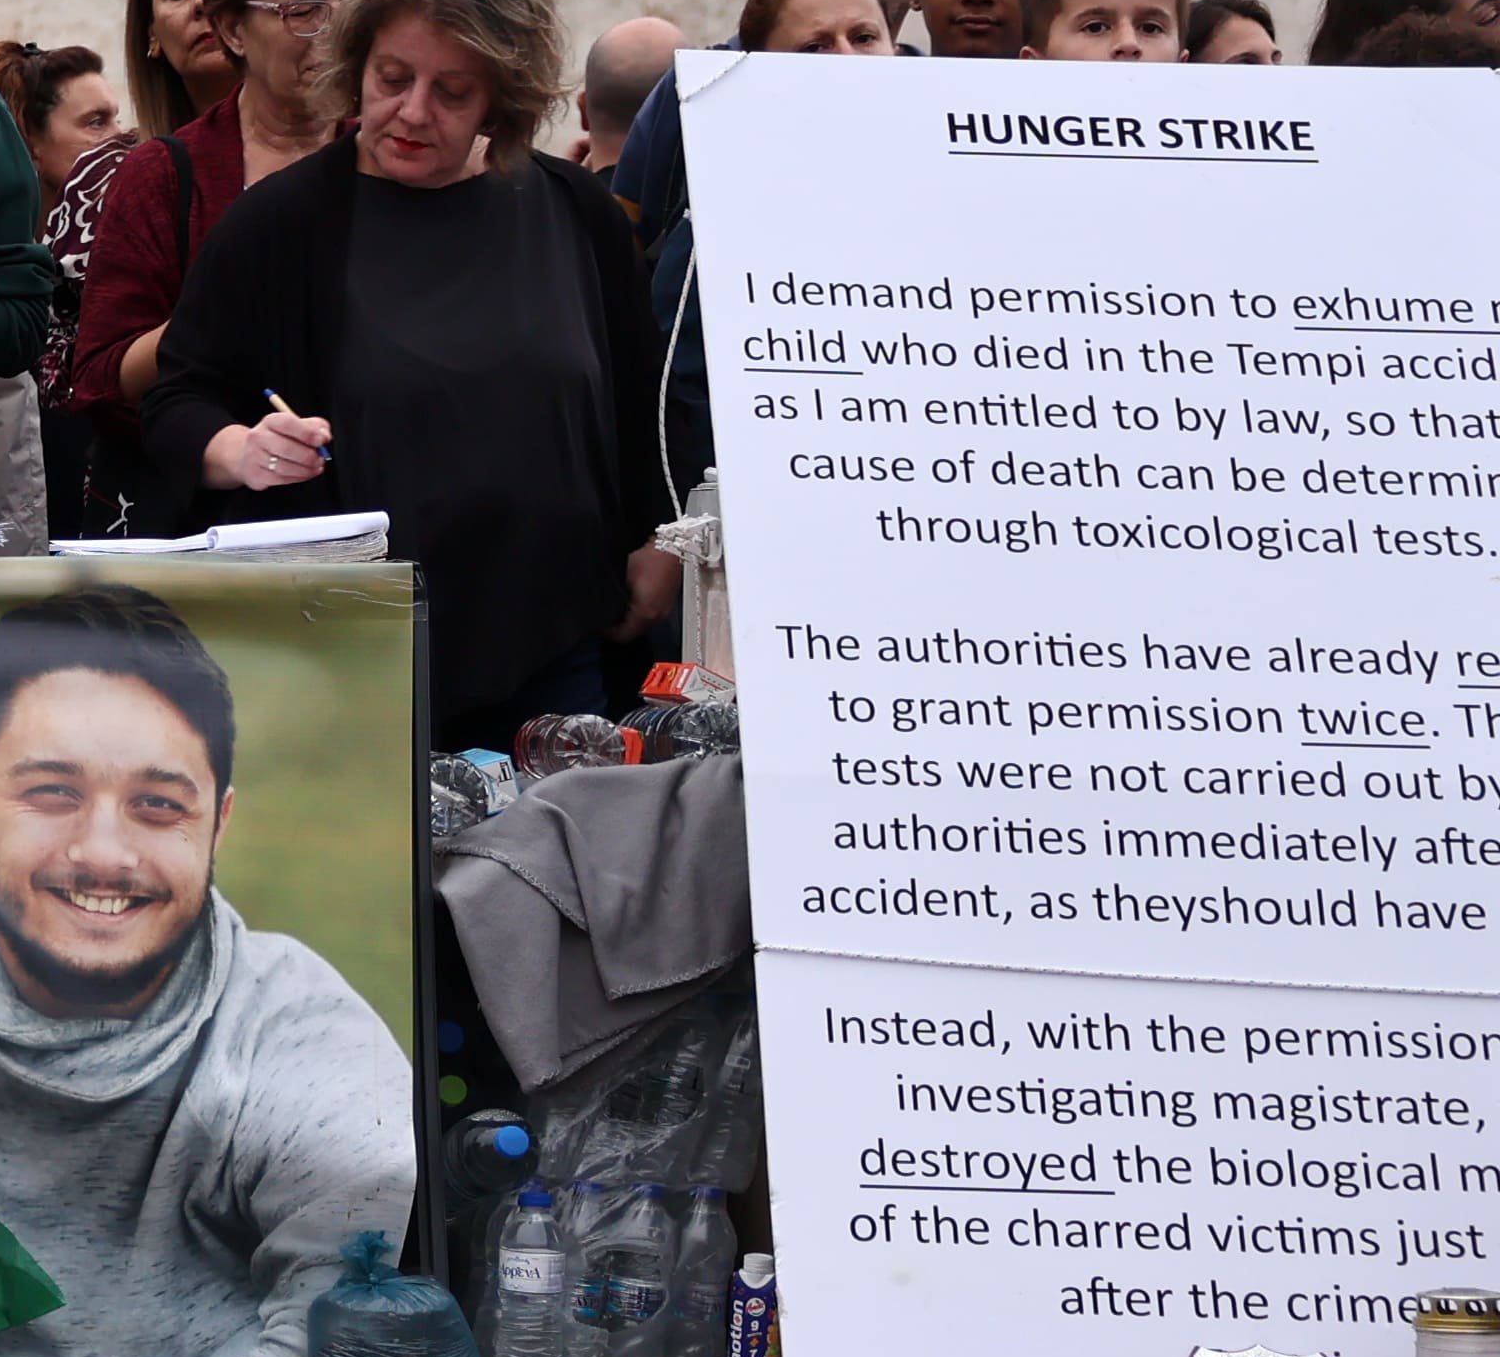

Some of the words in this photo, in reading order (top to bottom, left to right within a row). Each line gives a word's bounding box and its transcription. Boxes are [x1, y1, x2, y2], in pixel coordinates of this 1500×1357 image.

[945, 111, 1147, 149] HUNGER
[1157, 117, 1316, 153] STRIKE
[745, 271, 756, 305] I
[771, 270, 954, 311] demand
[969, 281, 1217, 320] permission
[1228, 287, 1278, 320] to
[1292, 285, 1475, 325] exhume
[742, 326, 847, 365] child
[860, 331, 958, 368] who
[972, 333, 1070, 372] died
[1083, 337, 1125, 373] in
[1137, 338, 1215, 376] the
[1225, 342, 1367, 387] Tempi
[753, 393, 800, 421] as
[813, 387, 824, 422] I
[840, 396, 909, 424] am
[923, 392, 1098, 430] entitled
[1110, 399, 1160, 432] to
[1173, 396, 1228, 442] by
[1241, 397, 1331, 443] law,
[1345, 410, 1397, 438] so
[1408, 402, 1500, 441] that
[788, 453, 916, 483] cause
[930, 448, 977, 485] of
[990, 449, 1121, 489] death
[1136, 463, 1215, 492] can
[1228, 455, 1287, 494] be
[874, 505, 1059, 555] through
[1070, 513, 1359, 561] toxicological
[1371, 523, 1498, 558] tests.
[774, 622, 861, 662] The
[876, 627, 1128, 670] authorities
[1141, 632, 1252, 673] have
[1267, 636, 1440, 686] already
[826, 689, 877, 724] to
[891, 693, 1014, 734] grant
[1027, 694, 1284, 737] permission
[1296, 699, 1441, 739] twice.
[830, 751, 943, 789] tests
[955, 754, 1075, 793] were
[1089, 759, 1170, 795] not
[1182, 759, 1348, 799] carried
[1362, 766, 1445, 802] out
[833, 811, 1088, 857] authorities
[1102, 818, 1398, 874] immediately
[802, 876, 1013, 927] accident,
[1029, 890, 1079, 921] as
[1373, 888, 1488, 932] have
[824, 1006, 1012, 1057] Instead,
[1025, 1011, 1132, 1053] with
[1145, 1013, 1227, 1055] the
[895, 1072, 1199, 1129] investigating
[1212, 1083, 1486, 1135] magistrate,
[858, 1136, 1099, 1191] destroyed
[1111, 1143, 1193, 1186] the
[1208, 1145, 1442, 1200] biological
[848, 1202, 898, 1244] of
[909, 1203, 991, 1247] the
[1006, 1206, 1193, 1253] charred
[1206, 1213, 1382, 1258] victims
[1395, 1218, 1488, 1268] just
[1059, 1274, 1174, 1318] after
[1186, 1278, 1270, 1321] the
